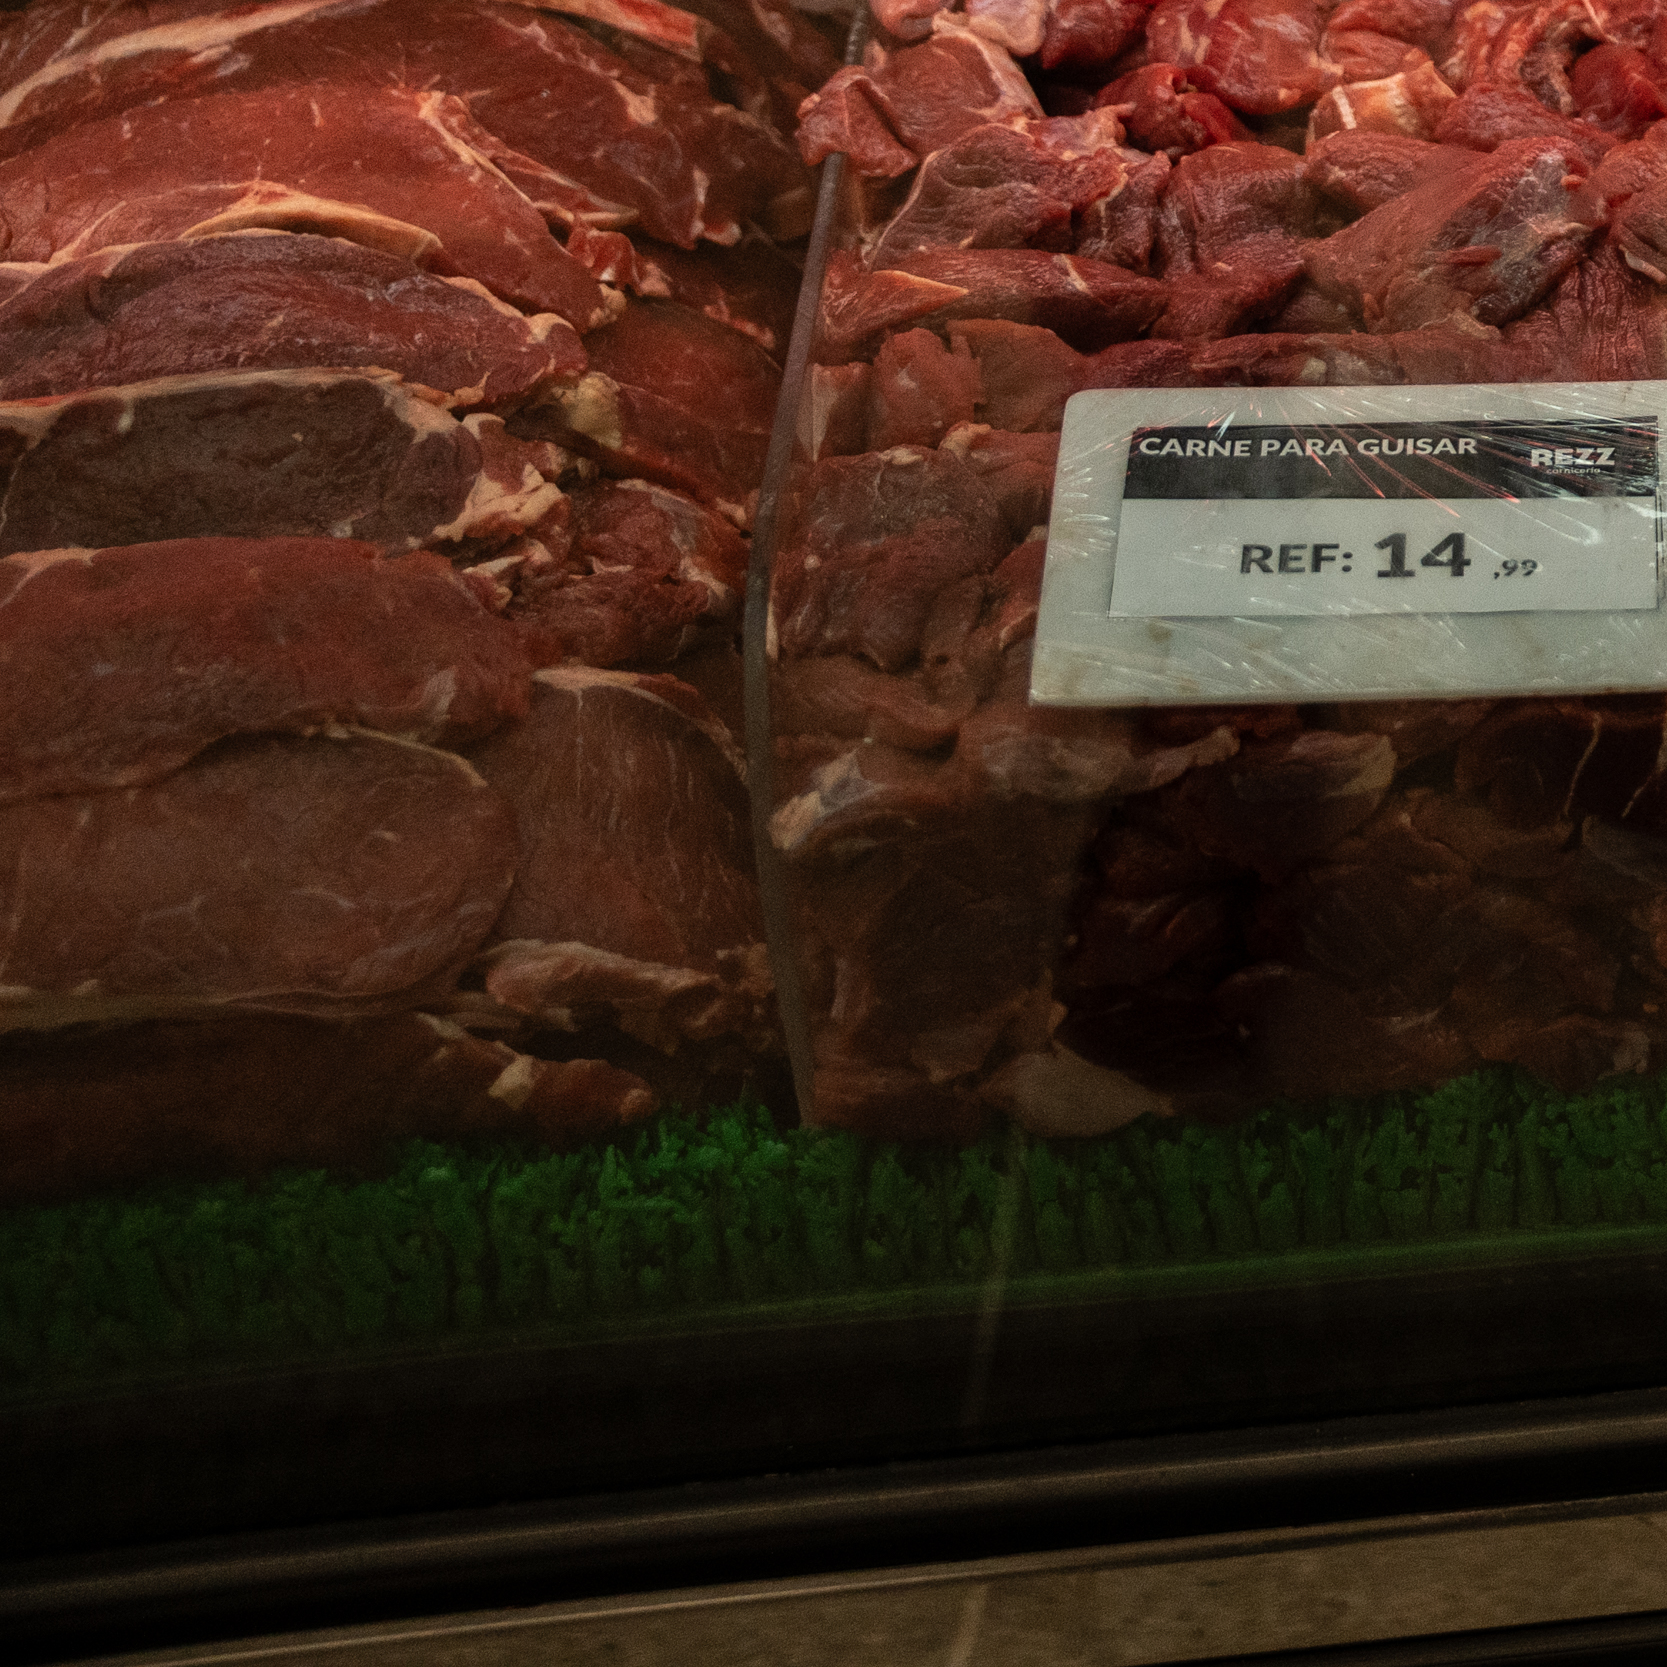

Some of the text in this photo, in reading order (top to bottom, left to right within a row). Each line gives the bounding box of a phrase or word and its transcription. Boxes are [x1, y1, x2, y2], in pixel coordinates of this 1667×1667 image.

[1138, 437, 1478, 457] CARNE PARA GUISAR
[1530, 447, 1617, 467] REZZ
[1239, 533, 1540, 581] REF: 14 ,99
